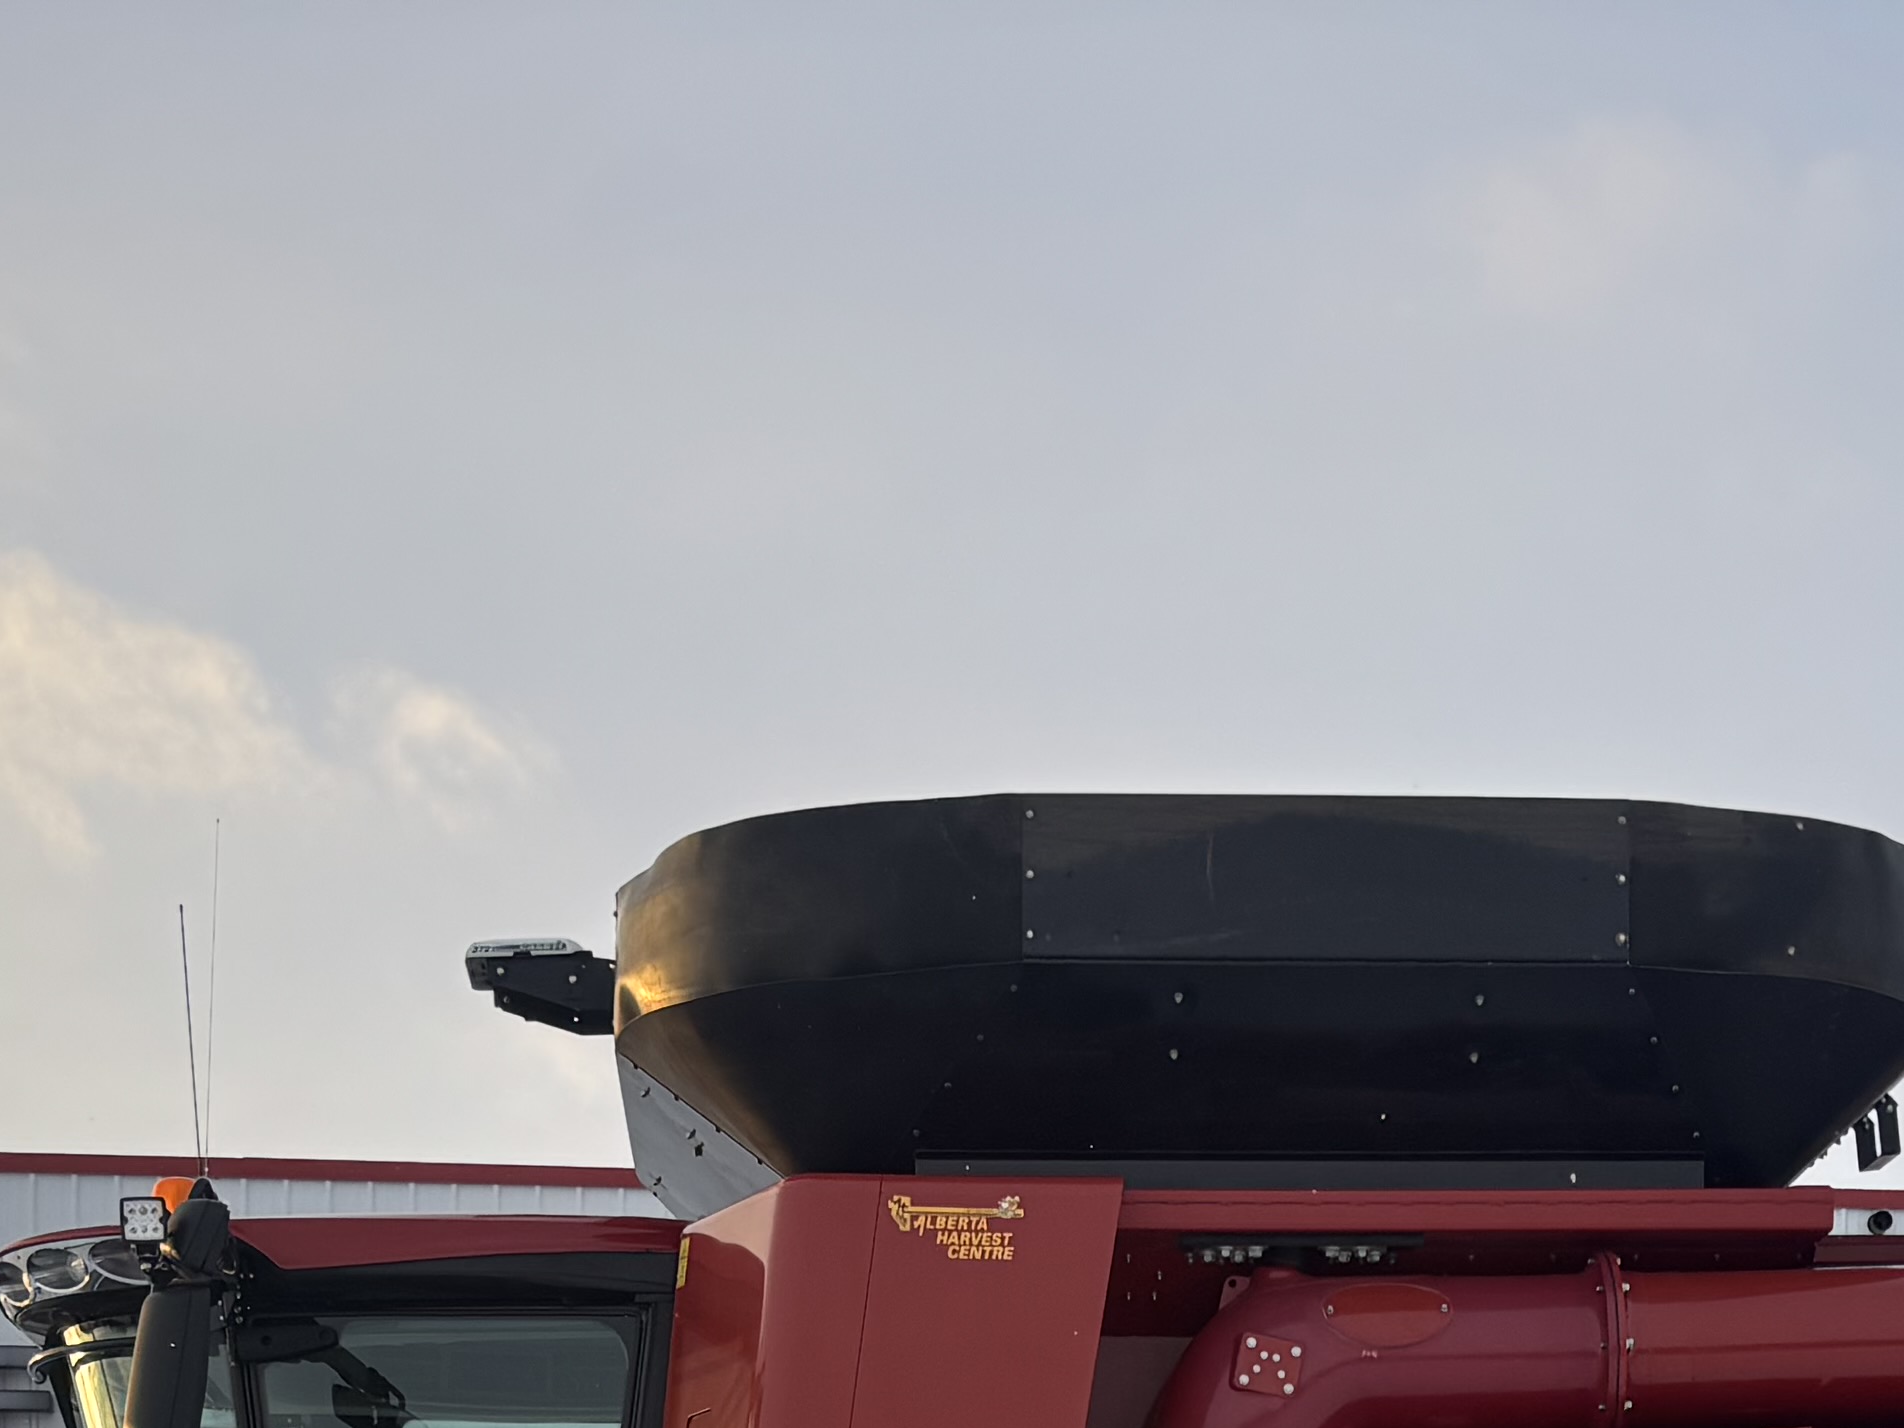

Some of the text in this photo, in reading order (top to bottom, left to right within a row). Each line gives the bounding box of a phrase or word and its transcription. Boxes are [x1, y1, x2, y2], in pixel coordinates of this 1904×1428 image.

[913, 1214, 988, 1236] ALBERTA
[936, 1231, 1013, 1246] HARVEST
[946, 1245, 1015, 1261] CENTRE
